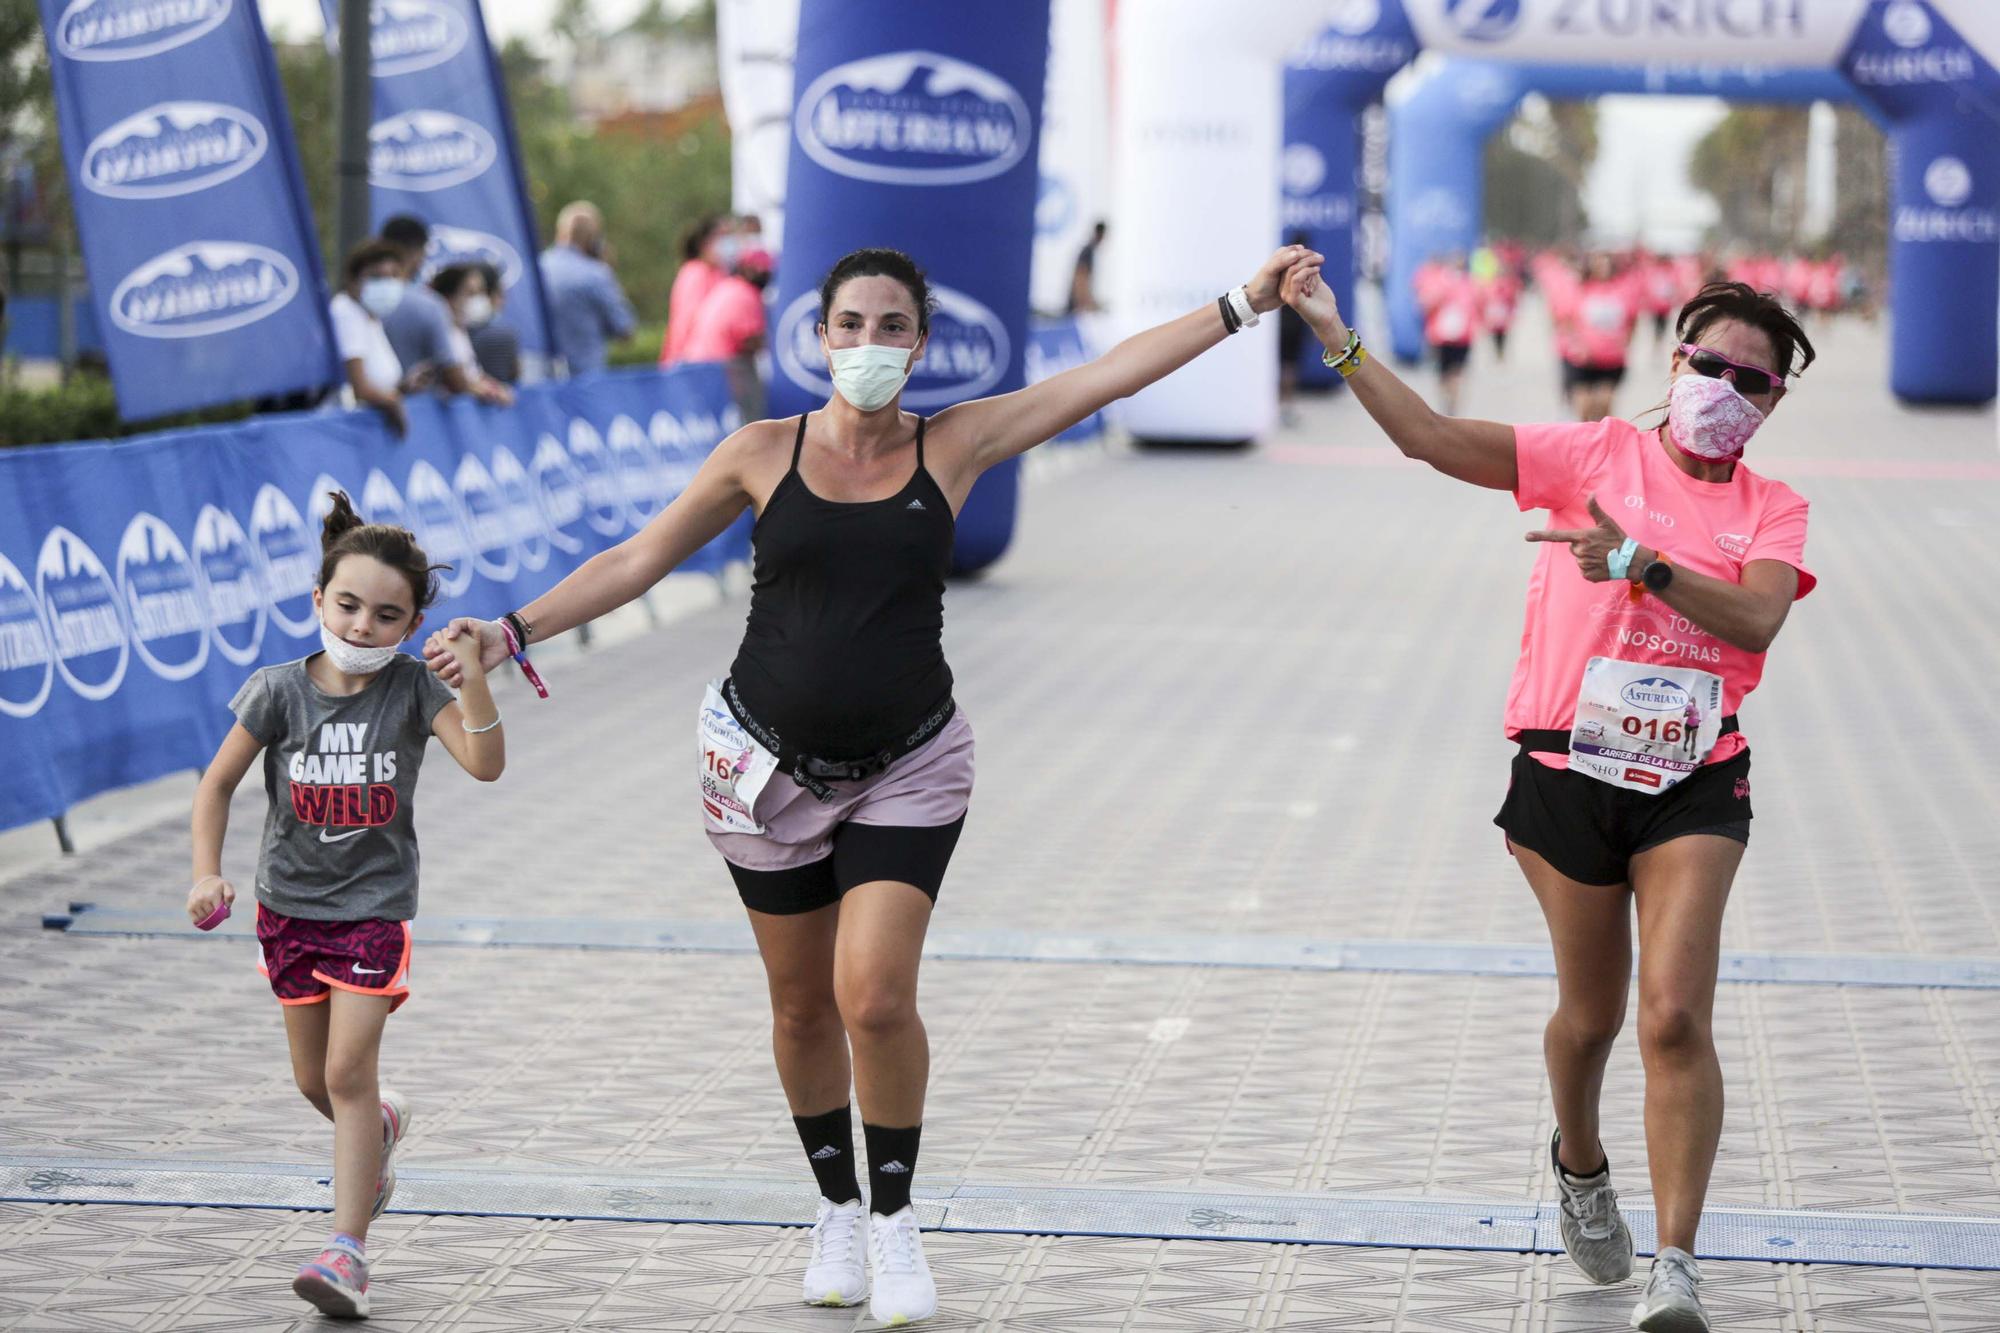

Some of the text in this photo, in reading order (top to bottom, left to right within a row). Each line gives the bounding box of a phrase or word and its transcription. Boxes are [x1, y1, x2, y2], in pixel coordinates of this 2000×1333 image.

[1550, 0, 1805, 37] ZURICH
[1853, 48, 1975, 84] ZURICH
[1625, 496, 1674, 528] OYHO
[1717, 535, 1746, 556] ASTUR
[1617, 627, 1720, 662] NOSOTRAS
[1626, 688, 1684, 705] ASTURIANA
[319, 723, 368, 753] MY
[744, 714, 780, 752] running
[907, 711, 942, 746] adidas
[1622, 716, 1682, 743] 016
[289, 751, 397, 784] GAME IS
[703, 750, 731, 780] 16
[1599, 748, 1694, 771] CARRERA DE LA MUJER
[289, 781, 397, 826] WILD
